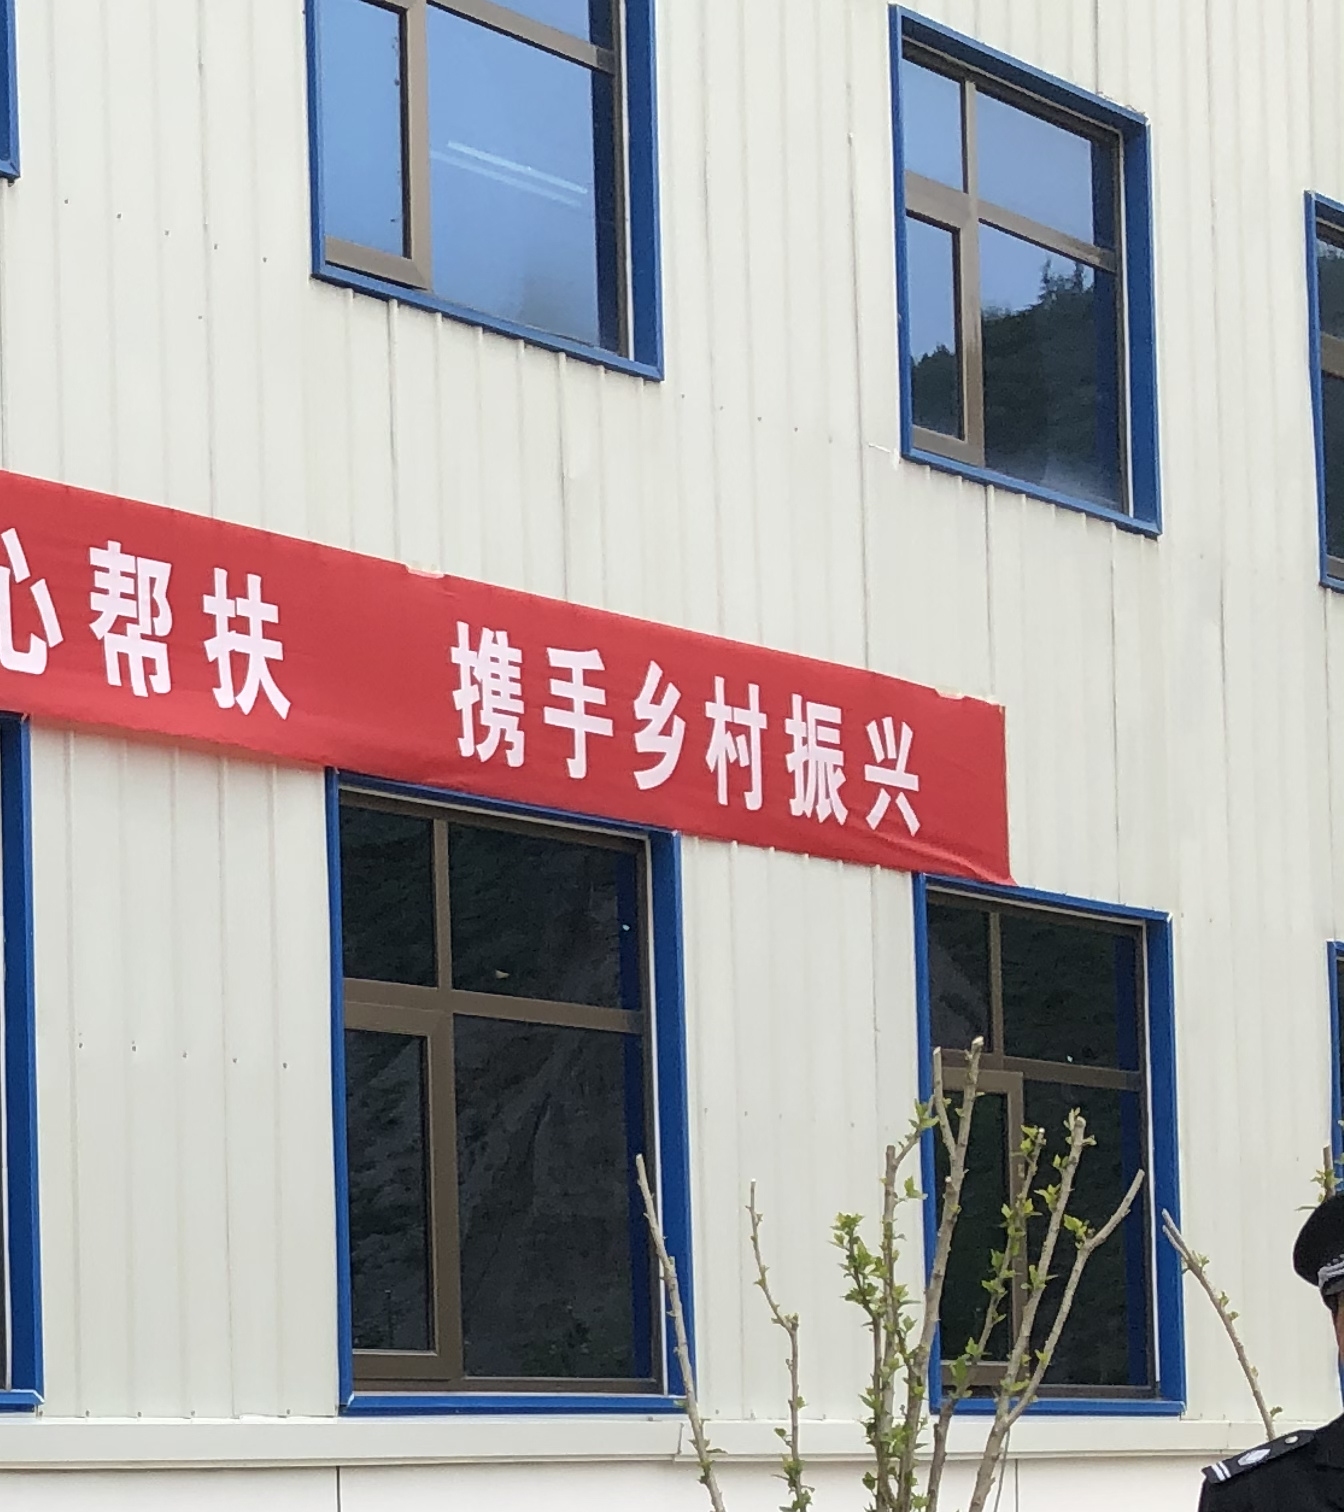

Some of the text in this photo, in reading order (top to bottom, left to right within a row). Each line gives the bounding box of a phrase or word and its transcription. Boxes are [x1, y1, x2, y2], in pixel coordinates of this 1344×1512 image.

[450, 620, 922, 836] 携手乡村振兴
